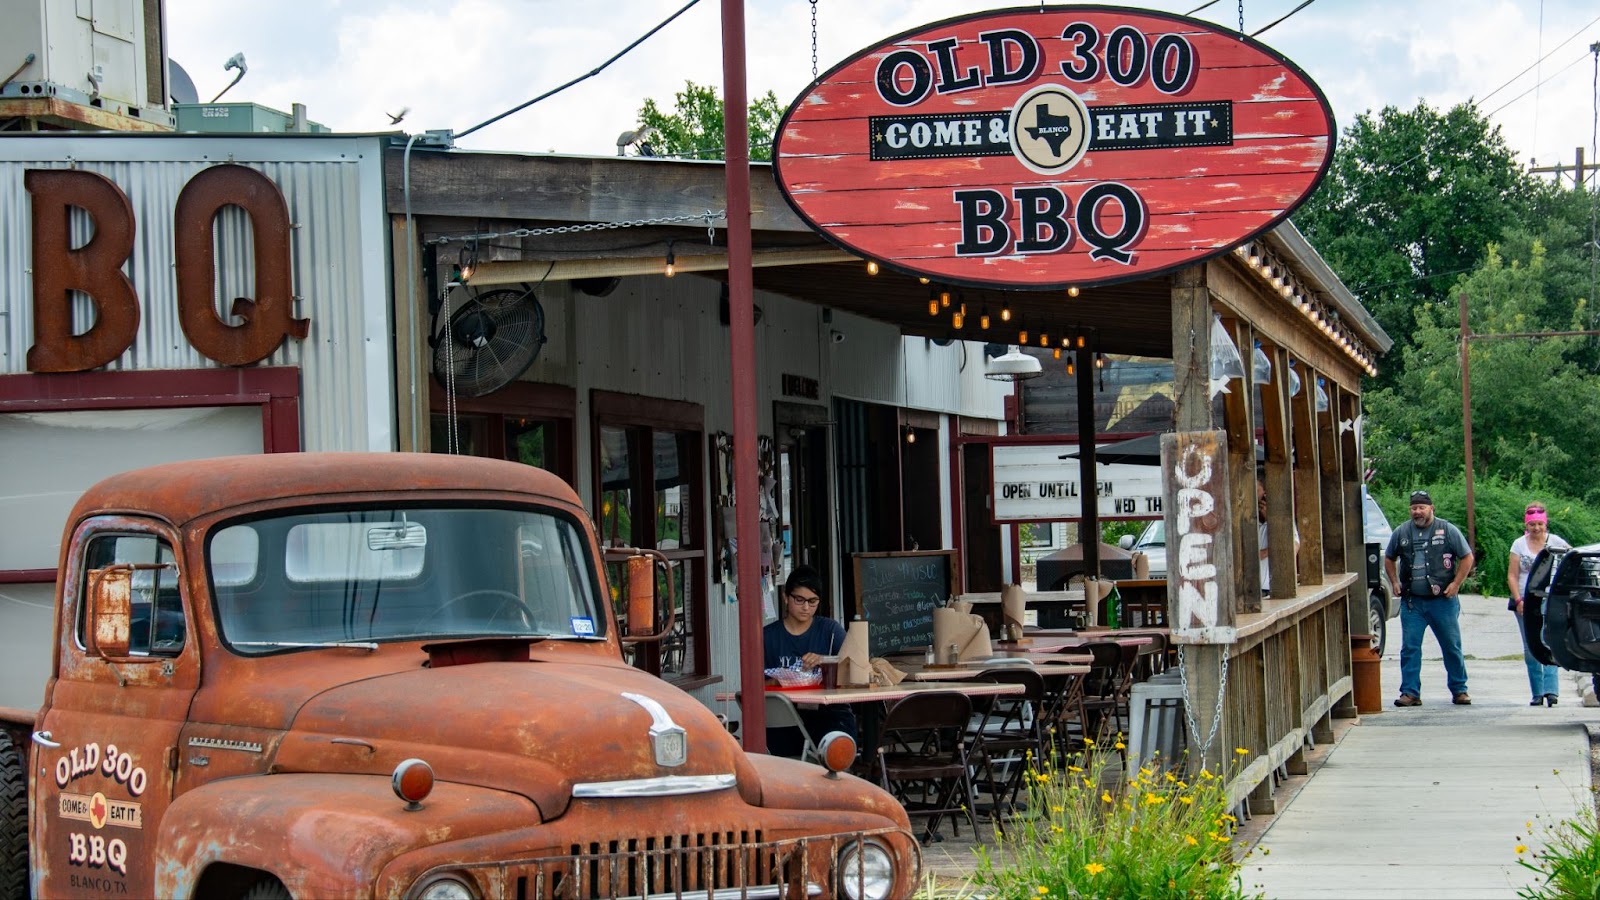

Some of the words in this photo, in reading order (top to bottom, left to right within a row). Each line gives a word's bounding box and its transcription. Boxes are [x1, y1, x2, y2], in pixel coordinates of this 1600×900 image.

[874, 28, 1043, 107] OLD
[1059, 21, 1197, 96] 300
[885, 120, 982, 149] COME
[987, 119, 1010, 145] &
[1097, 112, 1163, 141] EAT
[1174, 110, 1211, 138] IT
[1038, 125, 1069, 134] BLANCO
[953, 182, 1148, 265] BBQ
[1002, 483, 1031, 499] OPEN
[1039, 481, 1078, 499] UNTIL
[1114, 498, 1136, 514] WED
[1175, 443, 1219, 629] OPEN
[188, 737, 262, 752] INTERNATIONAL
[56, 742, 100, 788] OLD
[102, 744, 147, 796] 300
[111, 809, 126, 820] EAT
[127, 810, 136, 821] IT
[69, 832, 127, 875] BBQ
